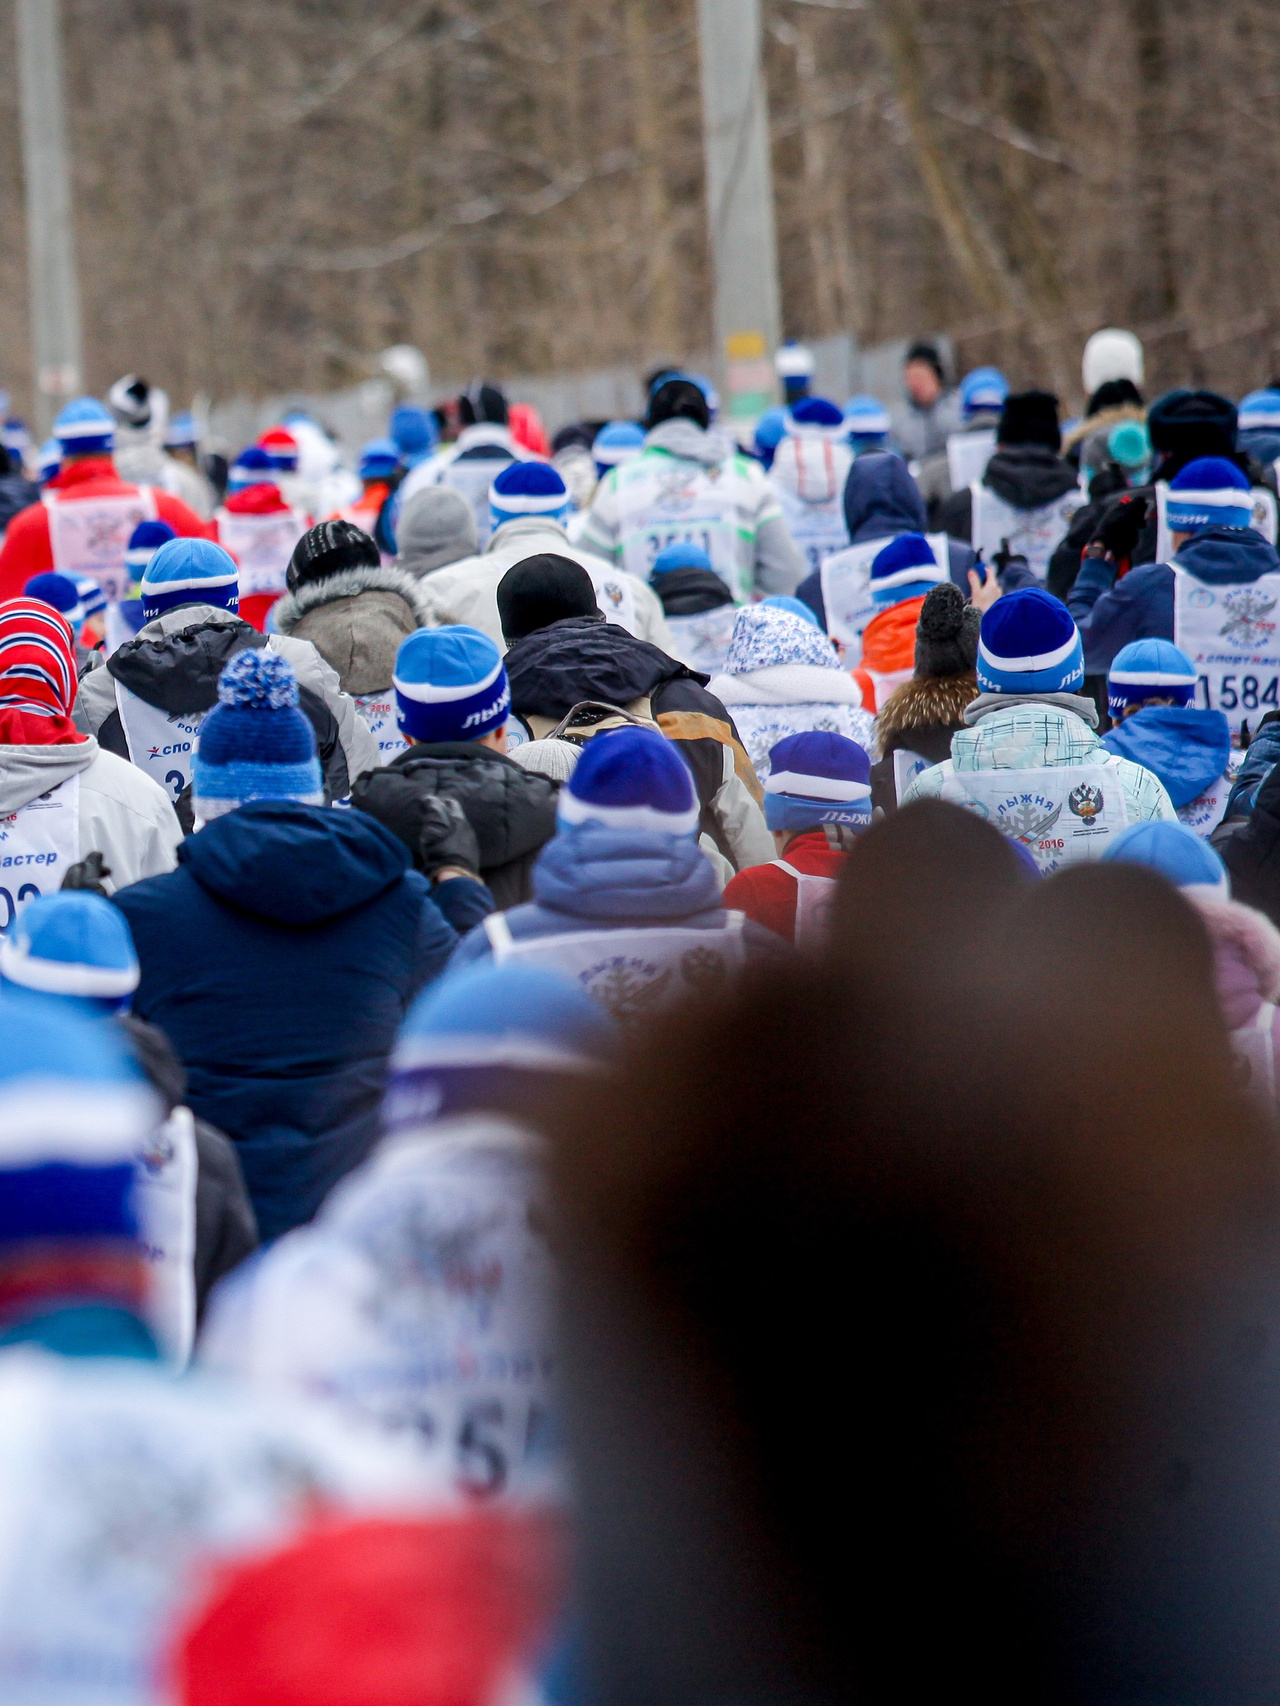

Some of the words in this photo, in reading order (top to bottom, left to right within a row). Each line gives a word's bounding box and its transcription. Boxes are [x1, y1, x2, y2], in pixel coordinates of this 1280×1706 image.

[1197, 674, 1279, 710] 1584
[997, 794, 1054, 815] ЛЫЖНЯ
[1038, 838, 1065, 850] 2016
